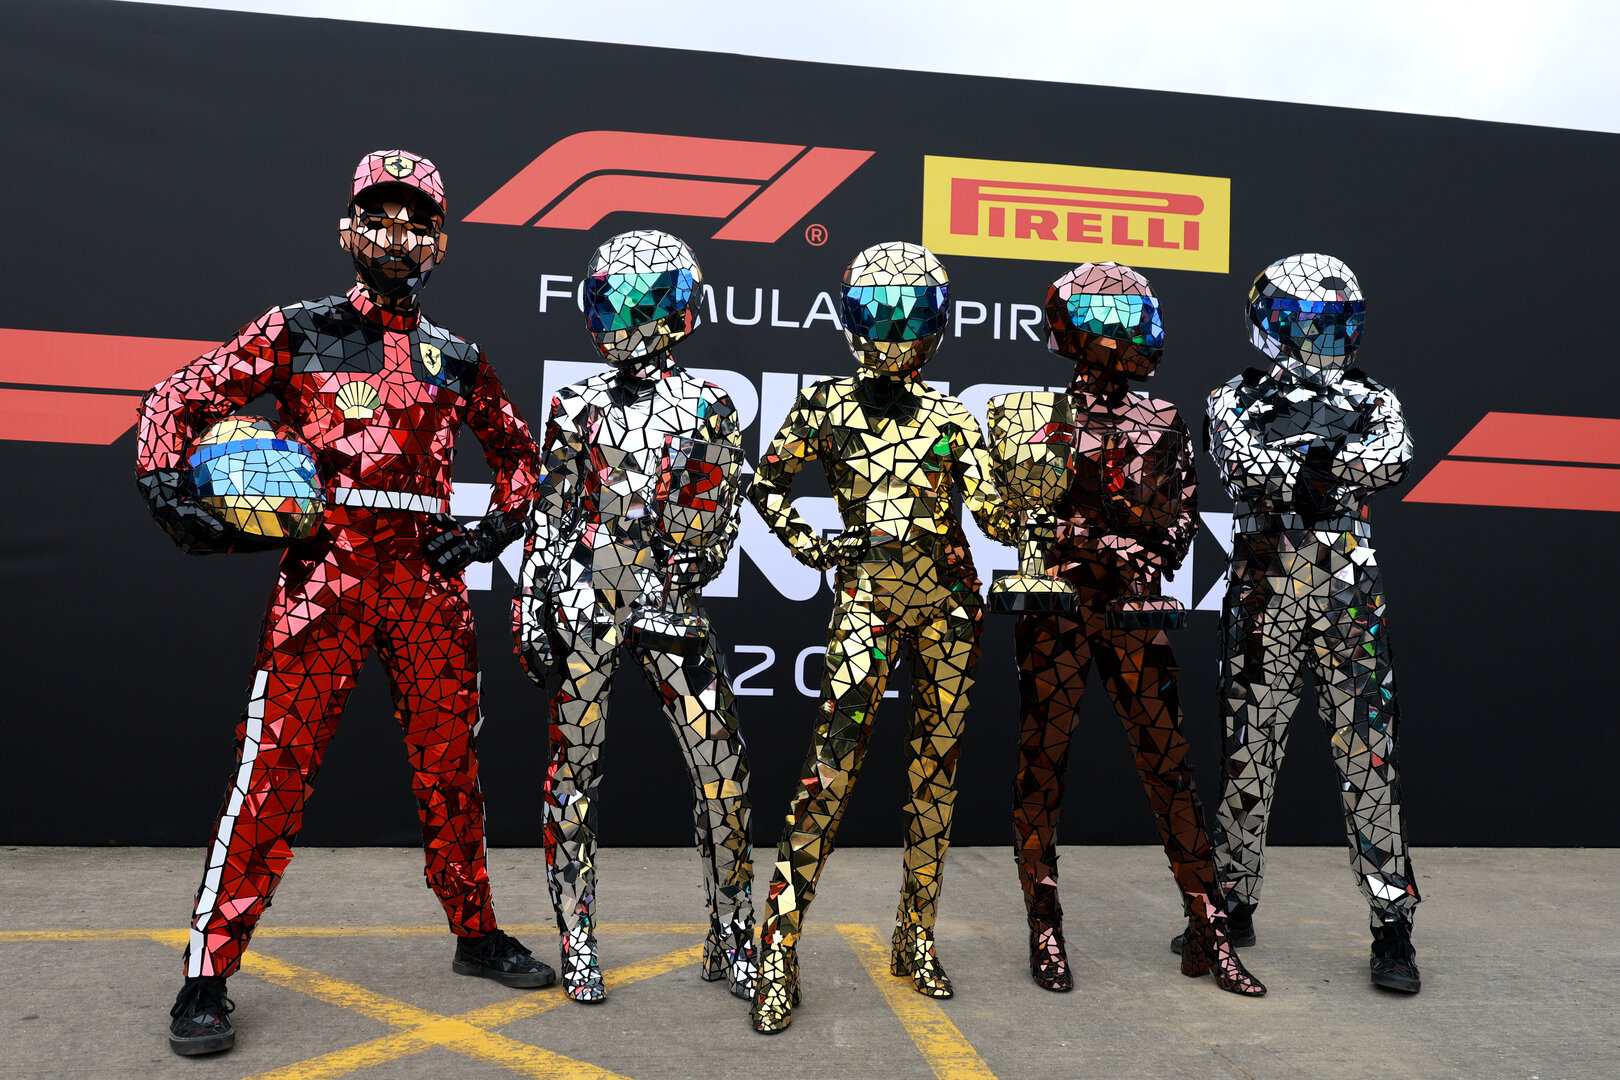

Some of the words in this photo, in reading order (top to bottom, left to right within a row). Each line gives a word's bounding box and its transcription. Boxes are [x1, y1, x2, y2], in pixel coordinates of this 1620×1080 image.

[461, 130, 877, 243] F1
[950, 177, 1205, 251] PIRELLI
[954, 300, 1043, 342] PIR
